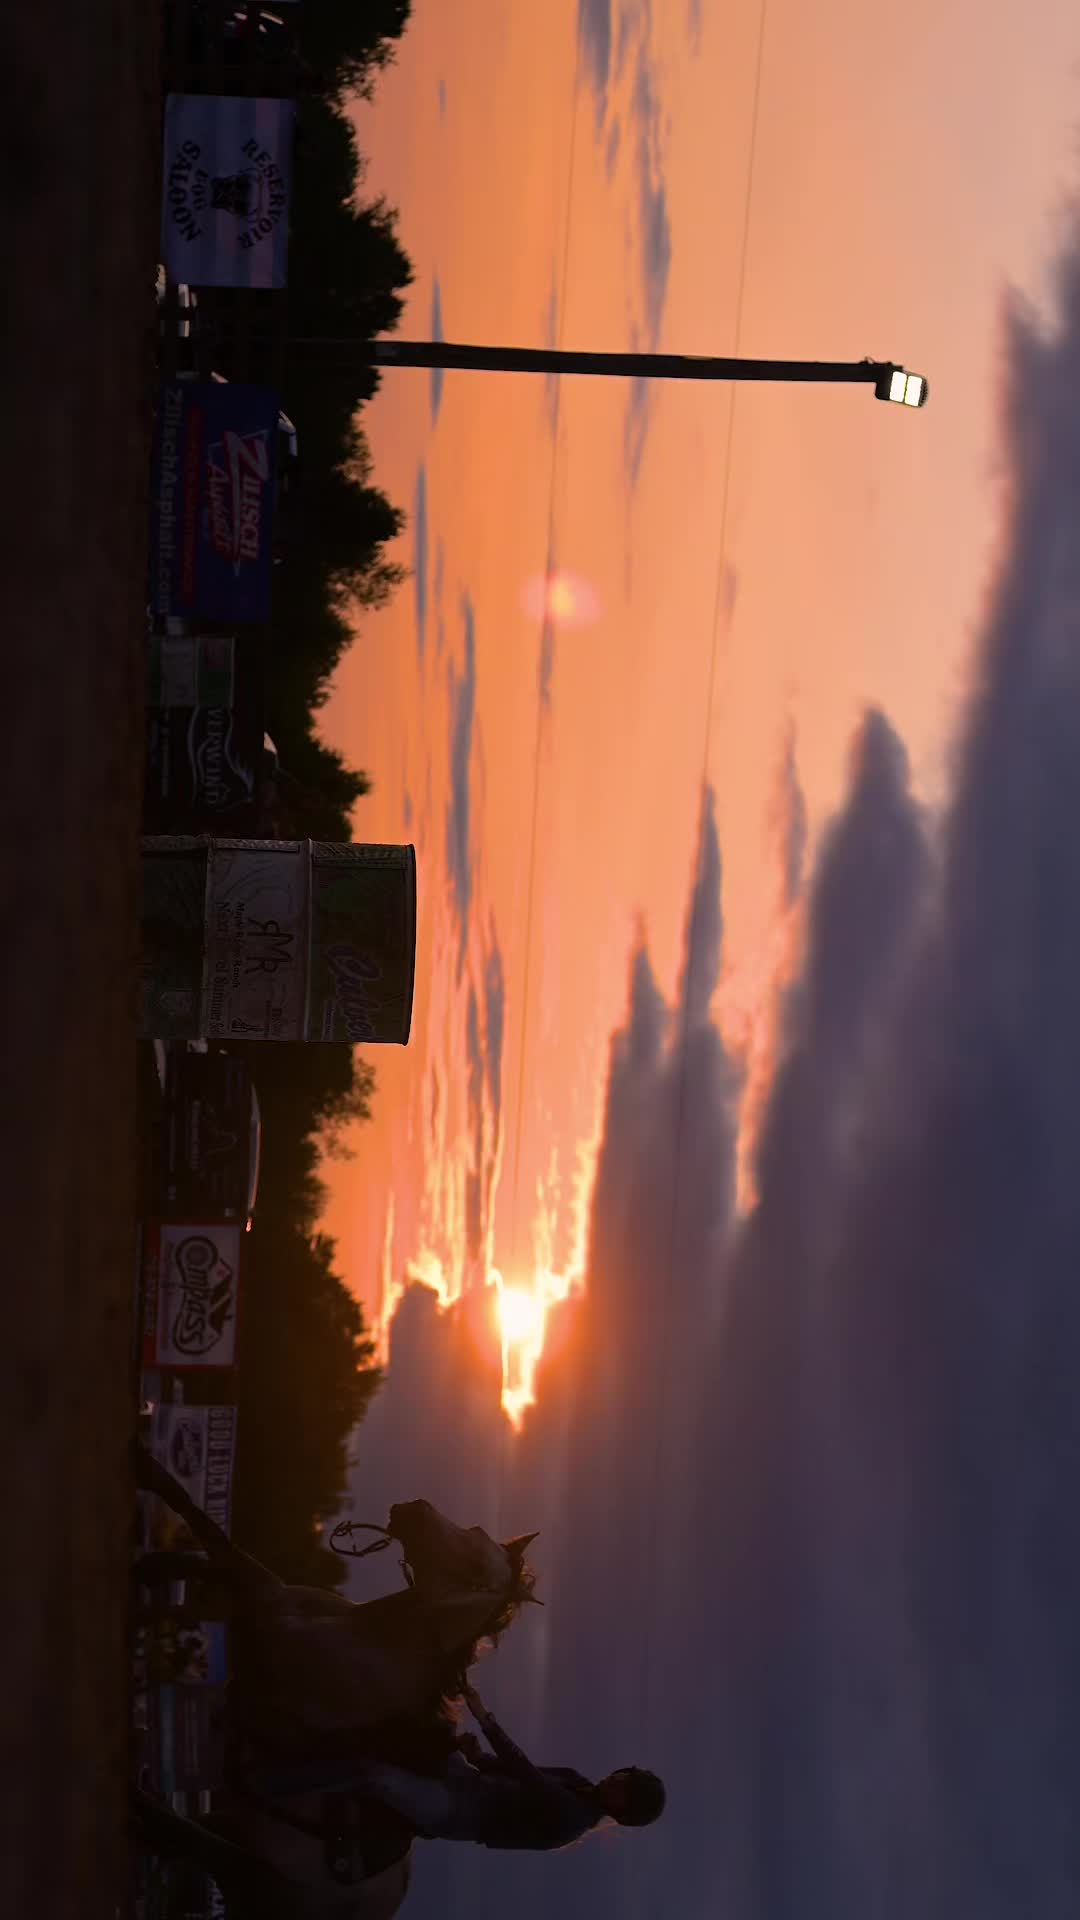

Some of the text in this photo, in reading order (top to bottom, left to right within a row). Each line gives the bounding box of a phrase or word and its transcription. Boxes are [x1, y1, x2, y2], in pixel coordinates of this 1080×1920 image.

[168, 141, 203, 242] SALOON
[237, 138, 287, 249] RESERVOIR
[204, 702, 226, 808] VERWIND
[209, 976, 229, 1021] Summer
[208, 1408, 233, 1450] GOOD
[207, 1455, 231, 1494] LUCK
